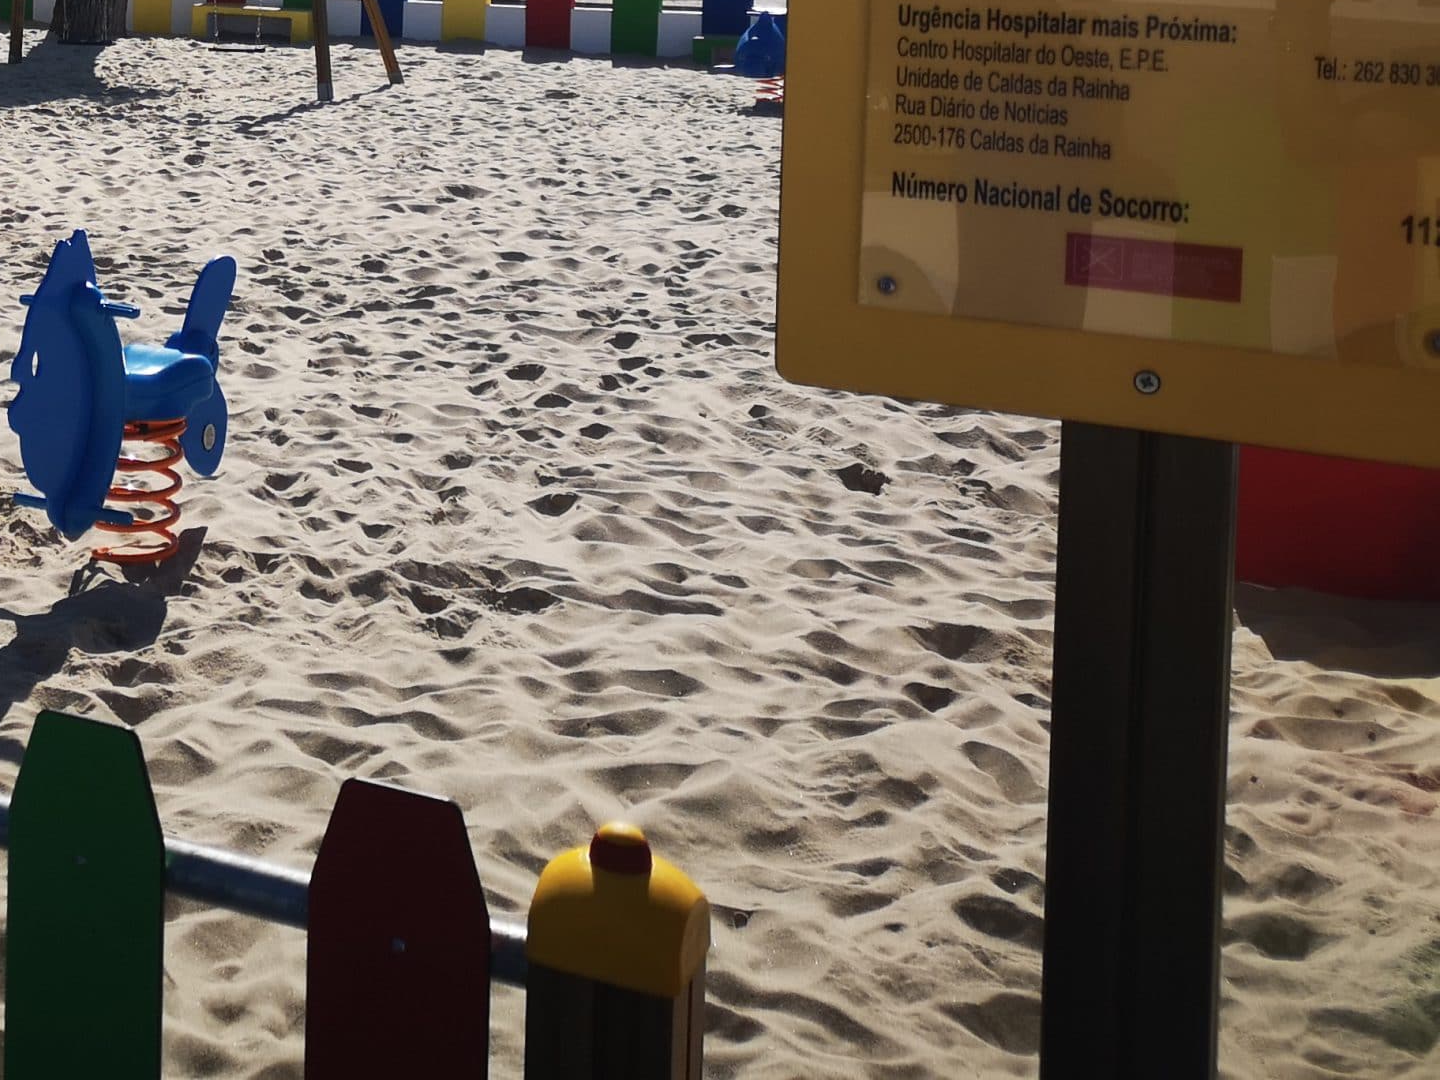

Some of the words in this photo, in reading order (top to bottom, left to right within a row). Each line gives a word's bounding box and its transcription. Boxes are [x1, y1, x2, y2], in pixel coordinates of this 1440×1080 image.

[898, 4, 981, 33] Urgência
[987, 8, 1086, 38] Hospitalar
[1092, 15, 1139, 39] mais
[1146, 16, 1237, 45] Próxima:
[897, 36, 948, 60] Centro
[953, 39, 1031, 66] Hospitalar
[1036, 43, 1055, 65] do
[1061, 44, 1114, 71] Oeste,
[1315, 56, 1346, 81] Tel.:
[1354, 61, 1384, 83] 262
[1389, 63, 1421, 85] 830
[897, 67, 959, 89] Unidade
[964, 69, 983, 92] de
[988, 72, 1042, 95] Caldas
[1048, 75, 1067, 97] da
[1072, 76, 1130, 101] Rainha
[895, 94, 925, 116] Rua
[931, 96, 975, 119] Diário
[980, 100, 999, 121] de
[894, 124, 965, 149] 2500-176
[970, 128, 1024, 153] Caldas
[1029, 132, 1049, 155] da
[1054, 135, 1111, 160] Rainha
[892, 171, 967, 203] Número
[974, 178, 1061, 212] Nacional
[1067, 187, 1092, 214] de
[1099, 188, 1189, 223] Socorro:
